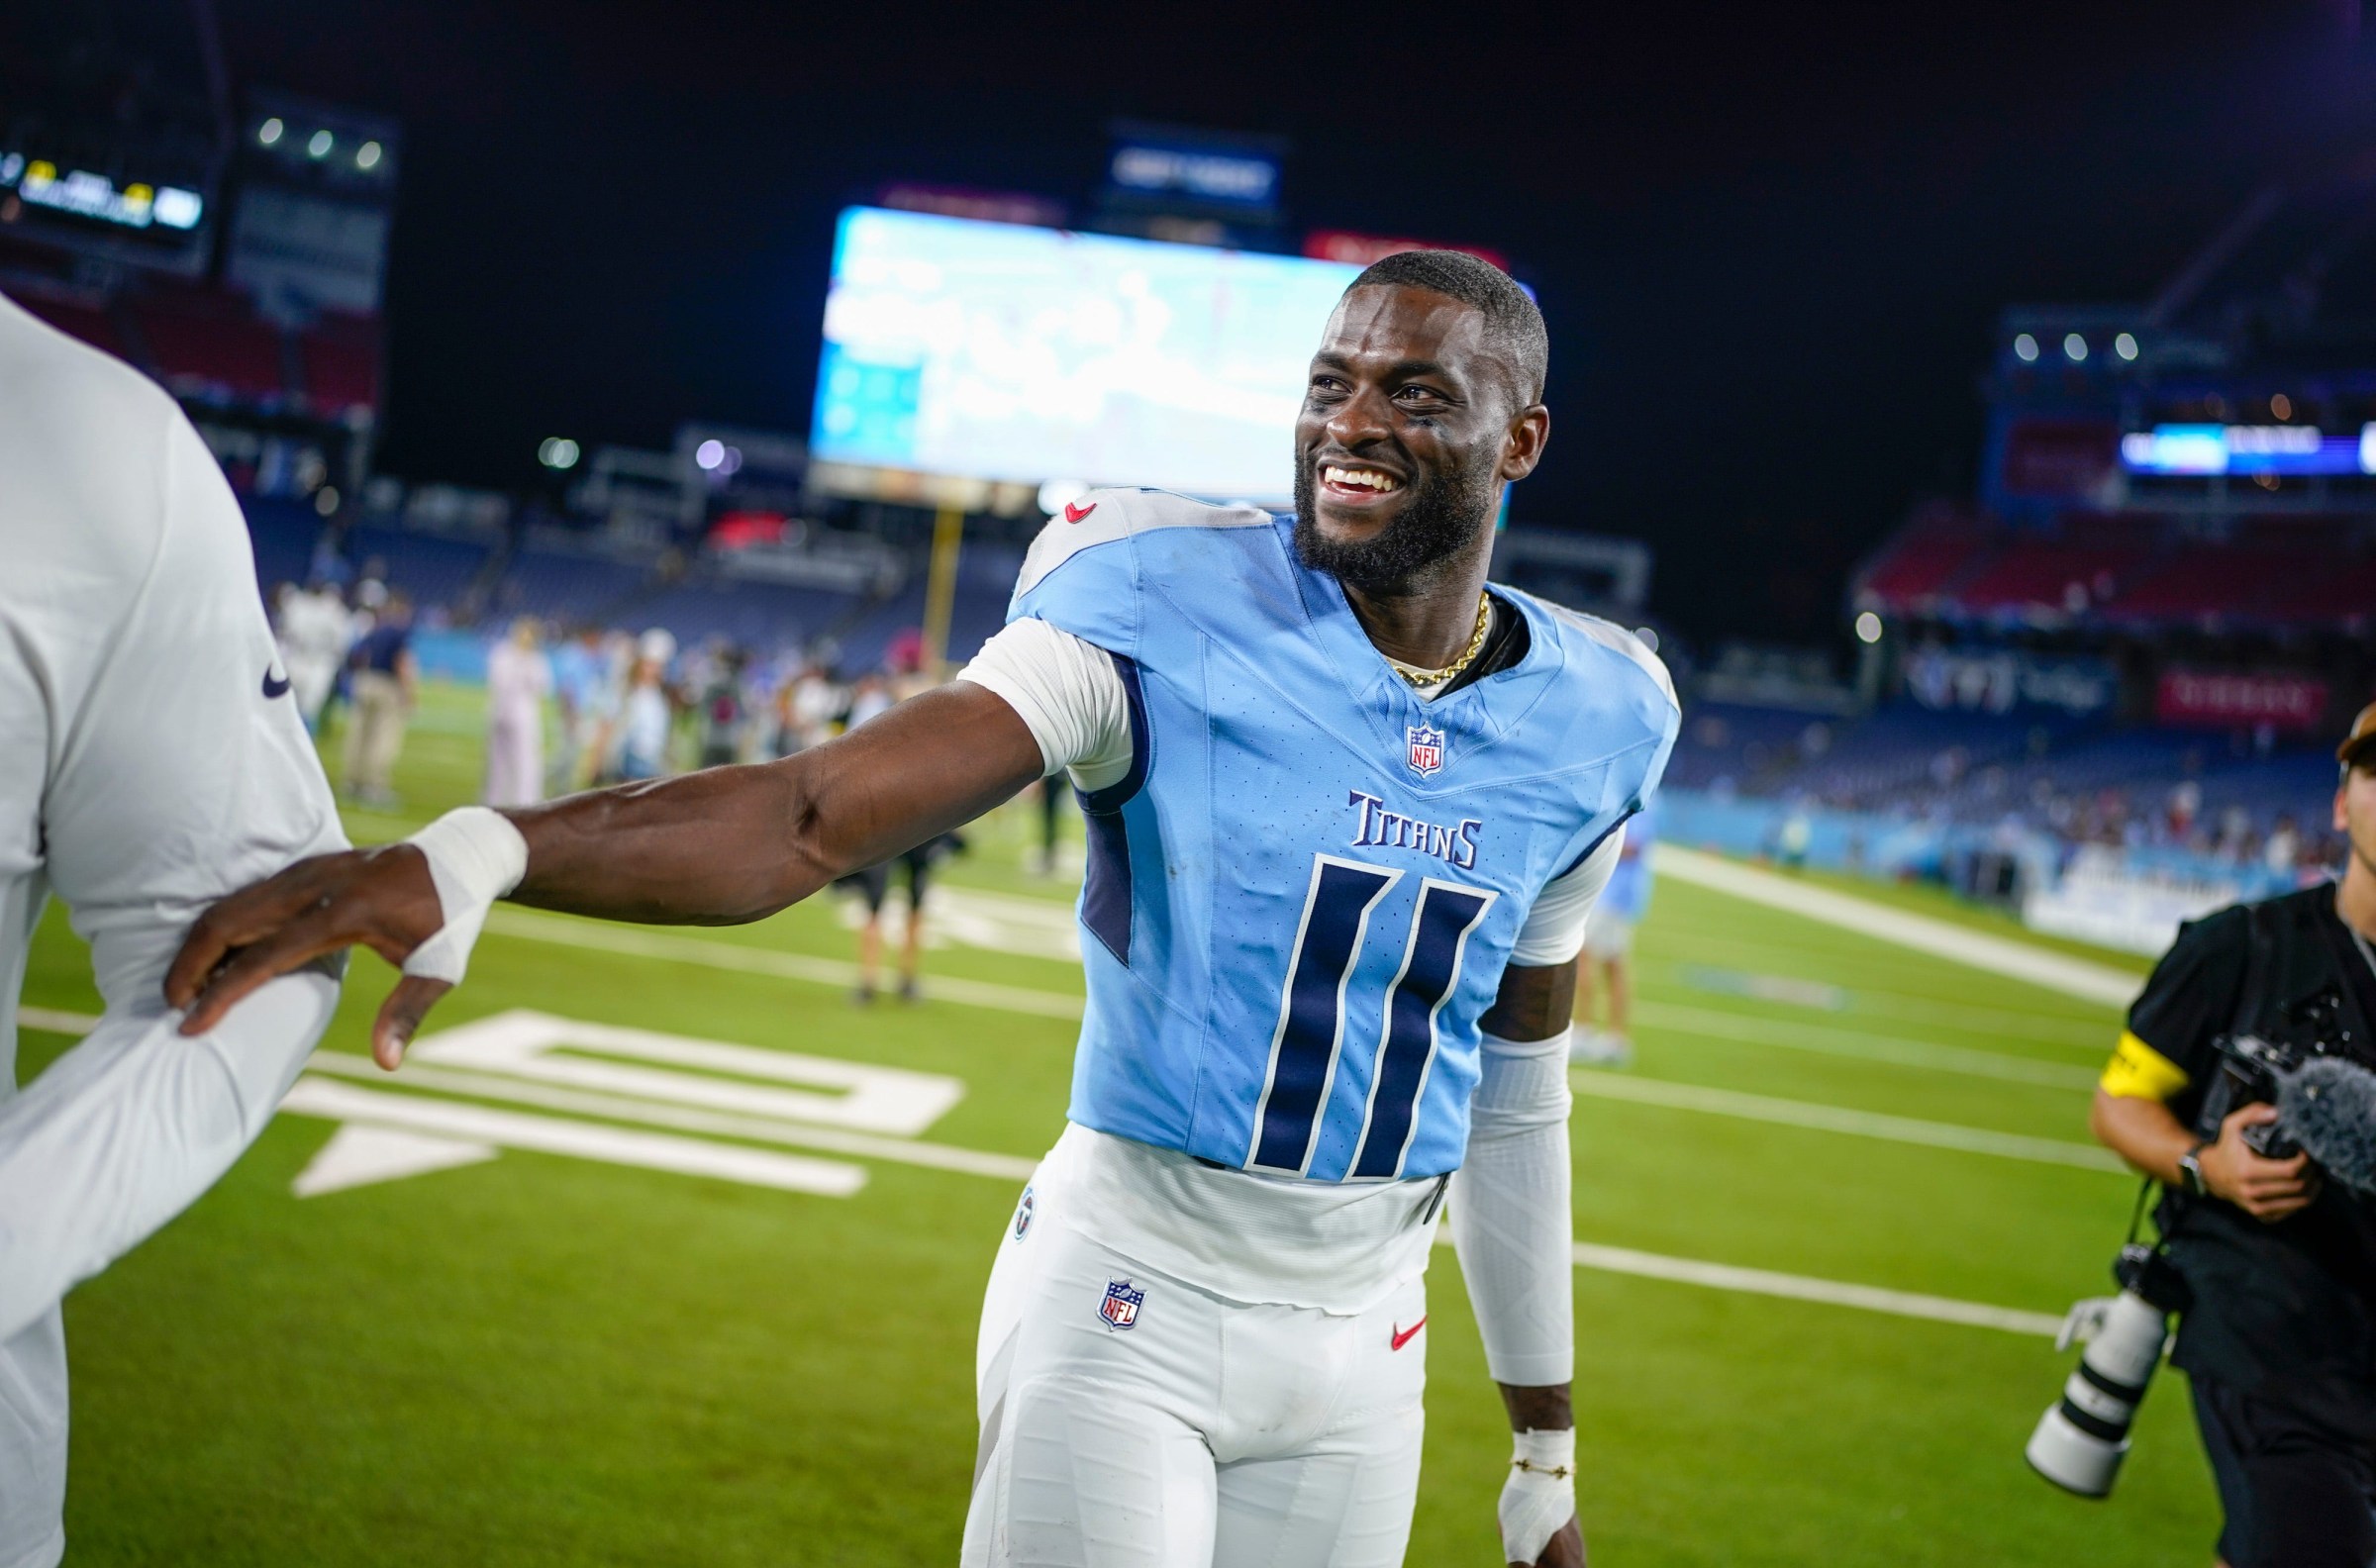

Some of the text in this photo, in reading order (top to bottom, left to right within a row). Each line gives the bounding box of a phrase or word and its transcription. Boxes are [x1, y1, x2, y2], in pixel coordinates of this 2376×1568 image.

[1413, 745, 1438, 768] NFL
[1349, 789, 1482, 870] TITANS
[1242, 852, 1500, 1183] 11
[1103, 1297, 1134, 1323] NFL
